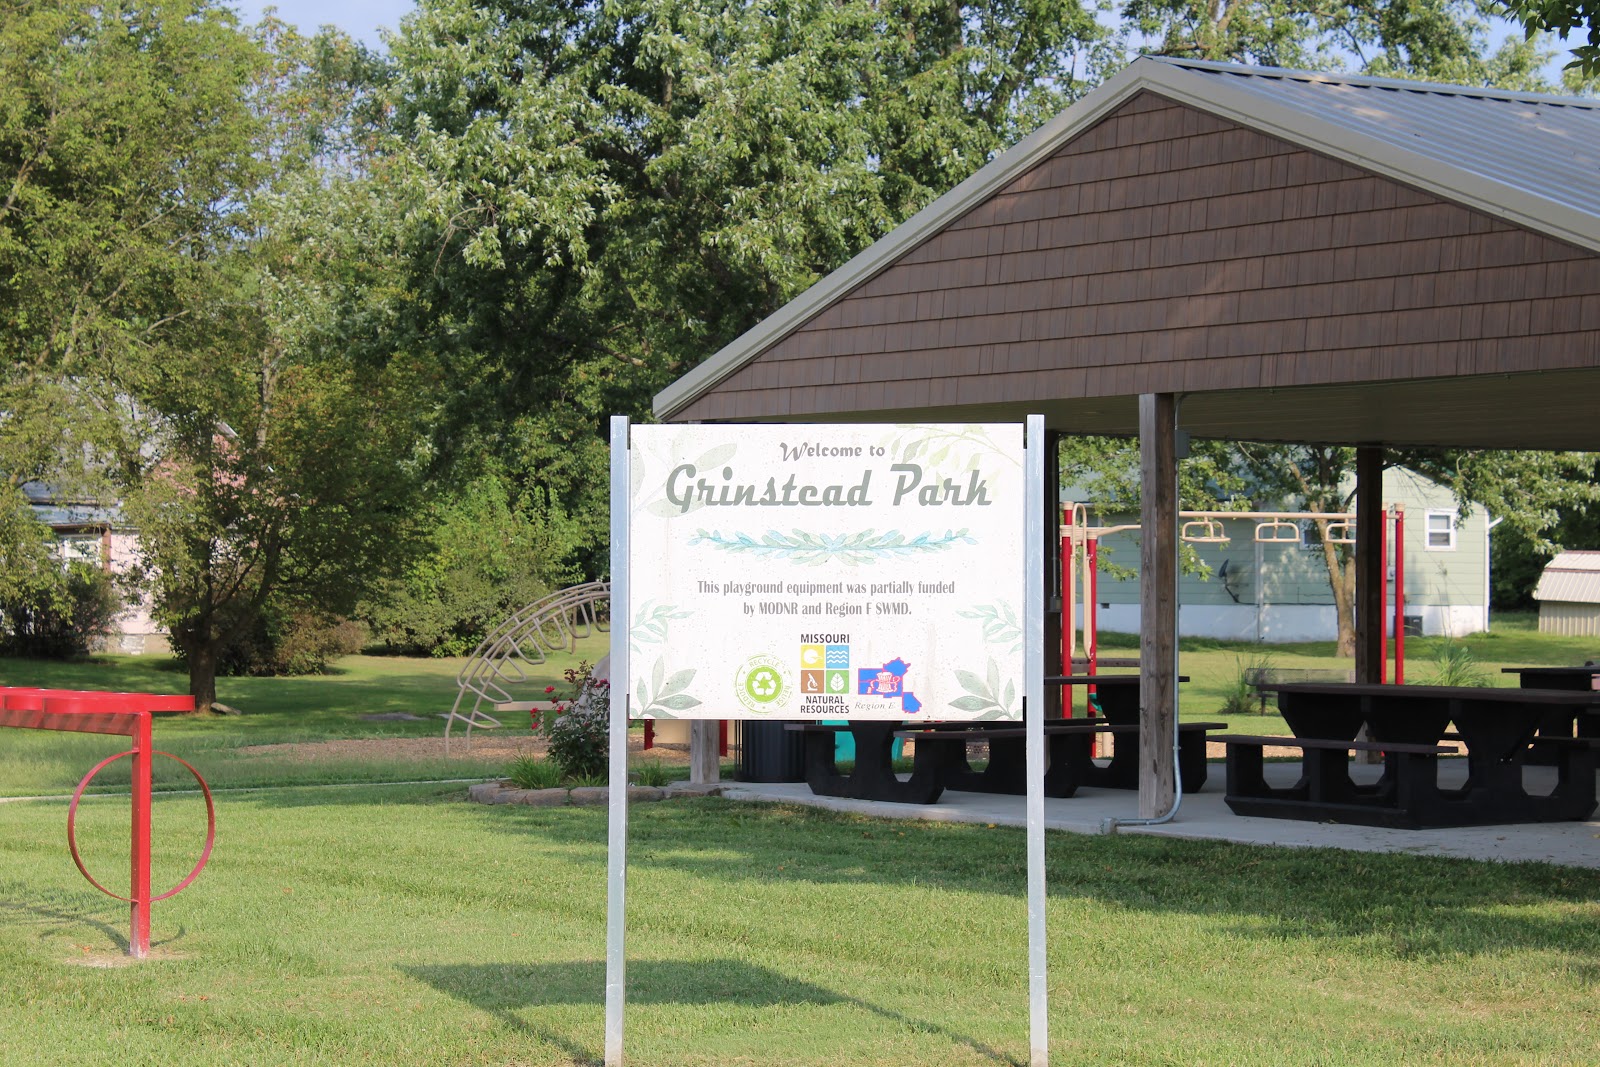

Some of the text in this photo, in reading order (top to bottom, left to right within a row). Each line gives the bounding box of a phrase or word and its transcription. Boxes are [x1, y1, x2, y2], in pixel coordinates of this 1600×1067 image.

[779, 442, 886, 462] Welcome to
[666, 463, 992, 514] Grinstead Park
[697, 580, 955, 597] This playground equipment was partially funded
[743, 602, 912, 618] by MODNR and Region F SWMD.
[800, 633, 850, 644] MISSOURI
[748, 657, 780, 668] RECYCLE
[738, 682, 756, 708] REDUCE
[805, 695, 845, 705] NATURAL
[800, 705, 850, 715] RESOURCES
[854, 701, 886, 712] Region
